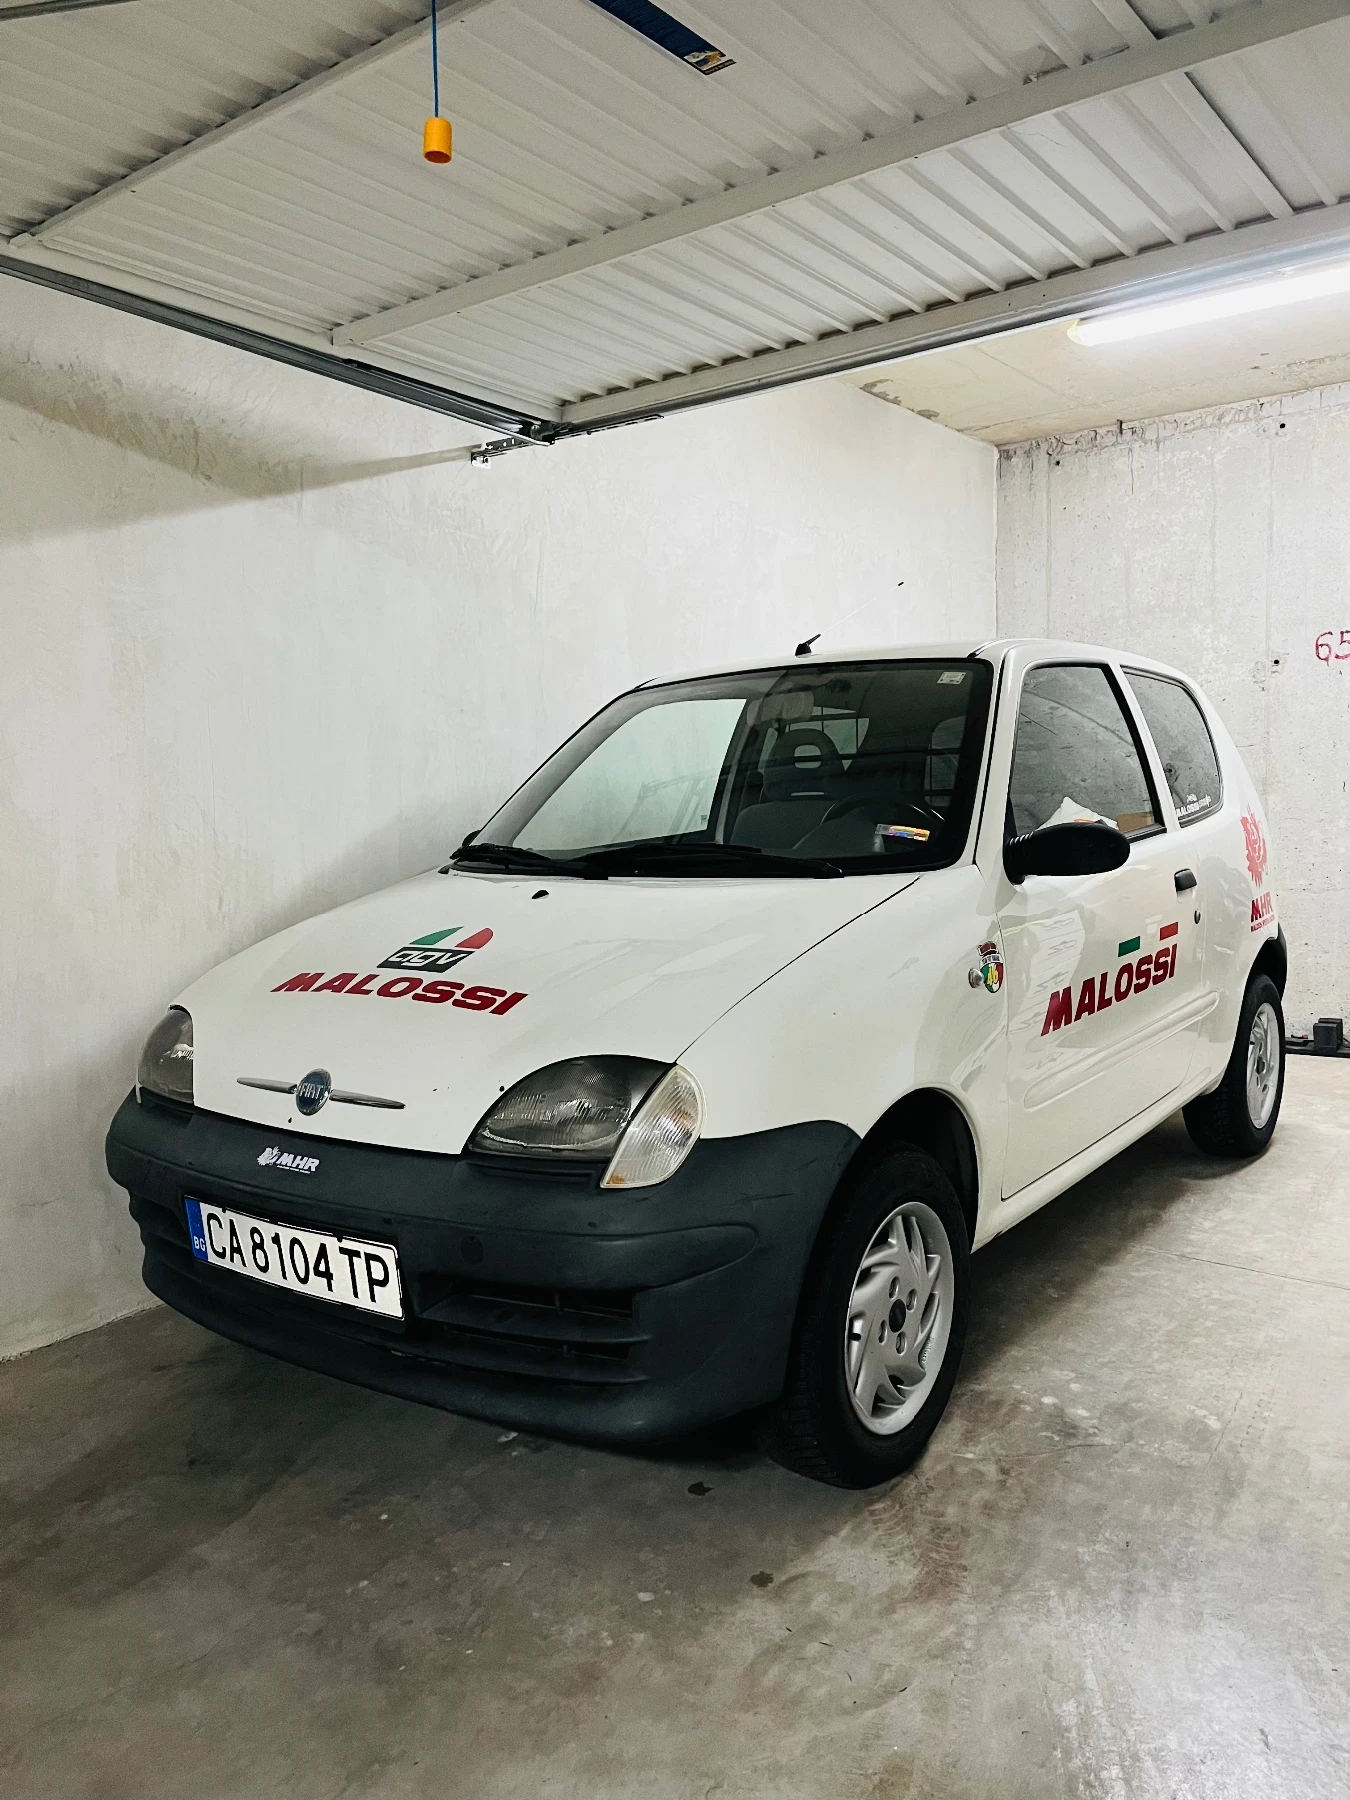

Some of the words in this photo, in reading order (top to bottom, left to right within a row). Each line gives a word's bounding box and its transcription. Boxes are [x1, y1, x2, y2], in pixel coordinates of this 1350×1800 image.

[1250, 891, 1274, 923] MHR
[270, 972, 529, 1016] MALOSSI
[1041, 943, 1178, 1037] MALOSSI
[300, 1082, 325, 1100] FIAT
[276, 1152, 320, 1172] MHR
[193, 1235, 206, 1251] BG
